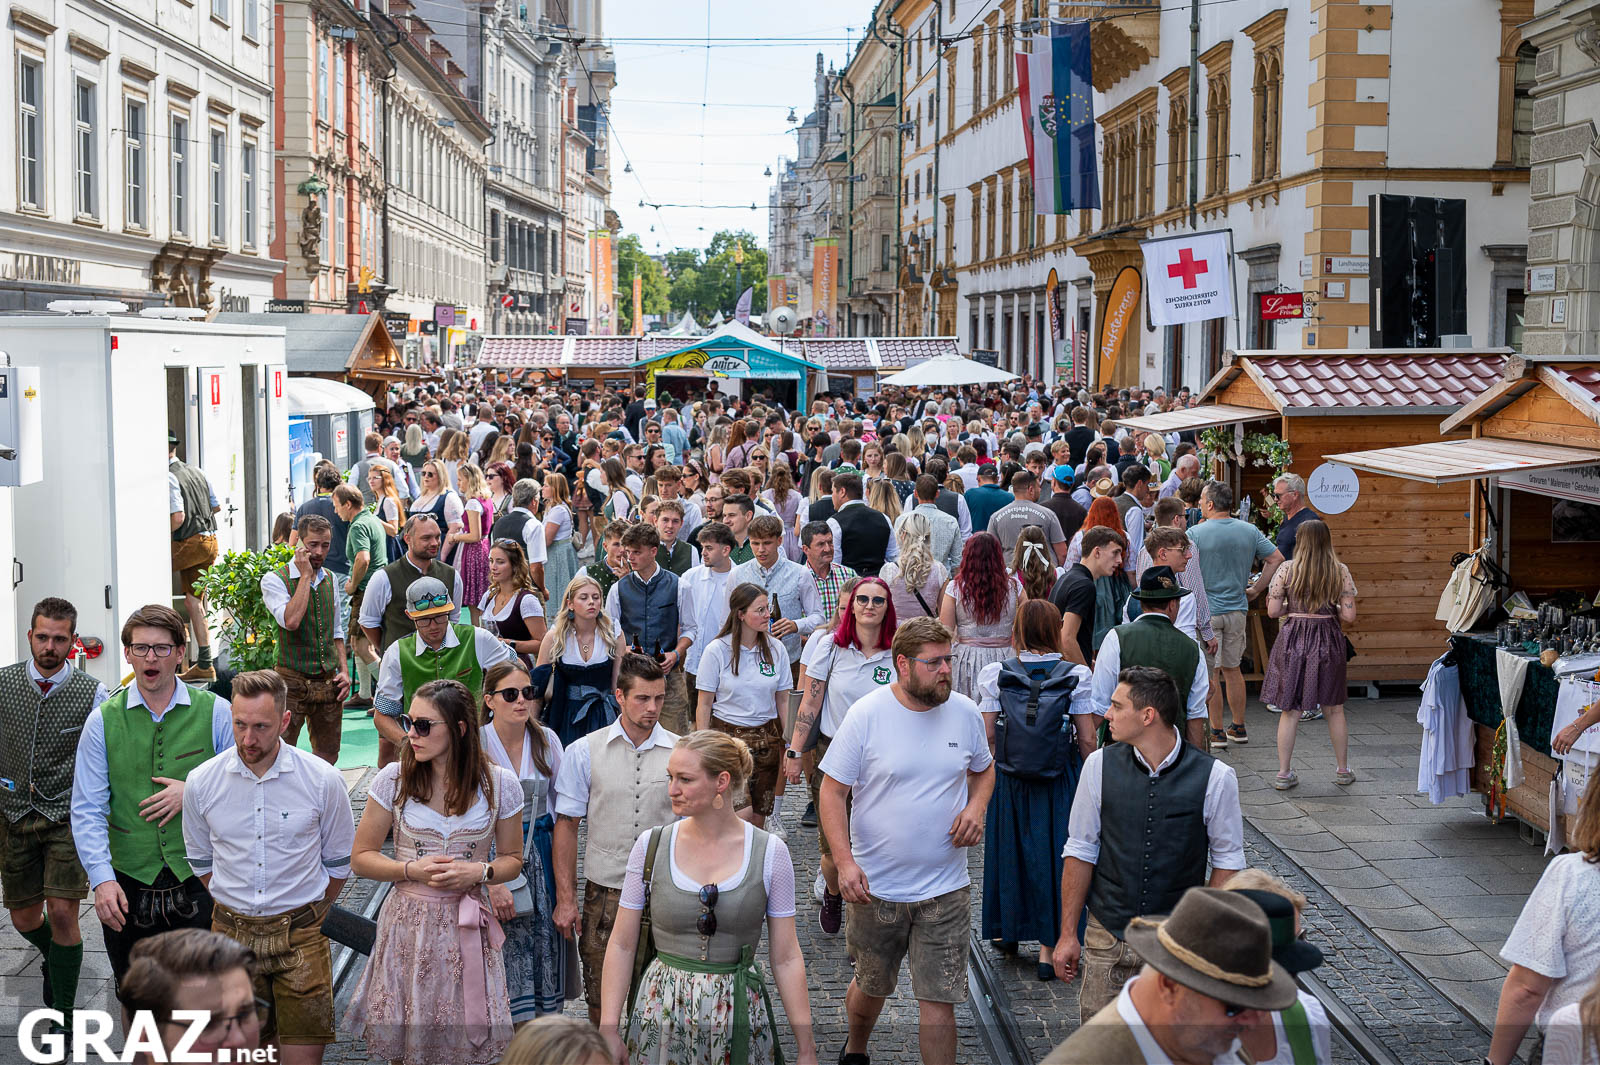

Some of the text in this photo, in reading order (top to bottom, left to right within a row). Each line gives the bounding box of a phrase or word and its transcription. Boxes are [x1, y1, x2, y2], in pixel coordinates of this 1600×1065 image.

[270, 303, 303, 312] fielmann
[1101, 285, 1137, 361] Aufsteirern
[1528, 474, 1548, 485] Gravuren
[1574, 482, 1600, 495] Geschenke
